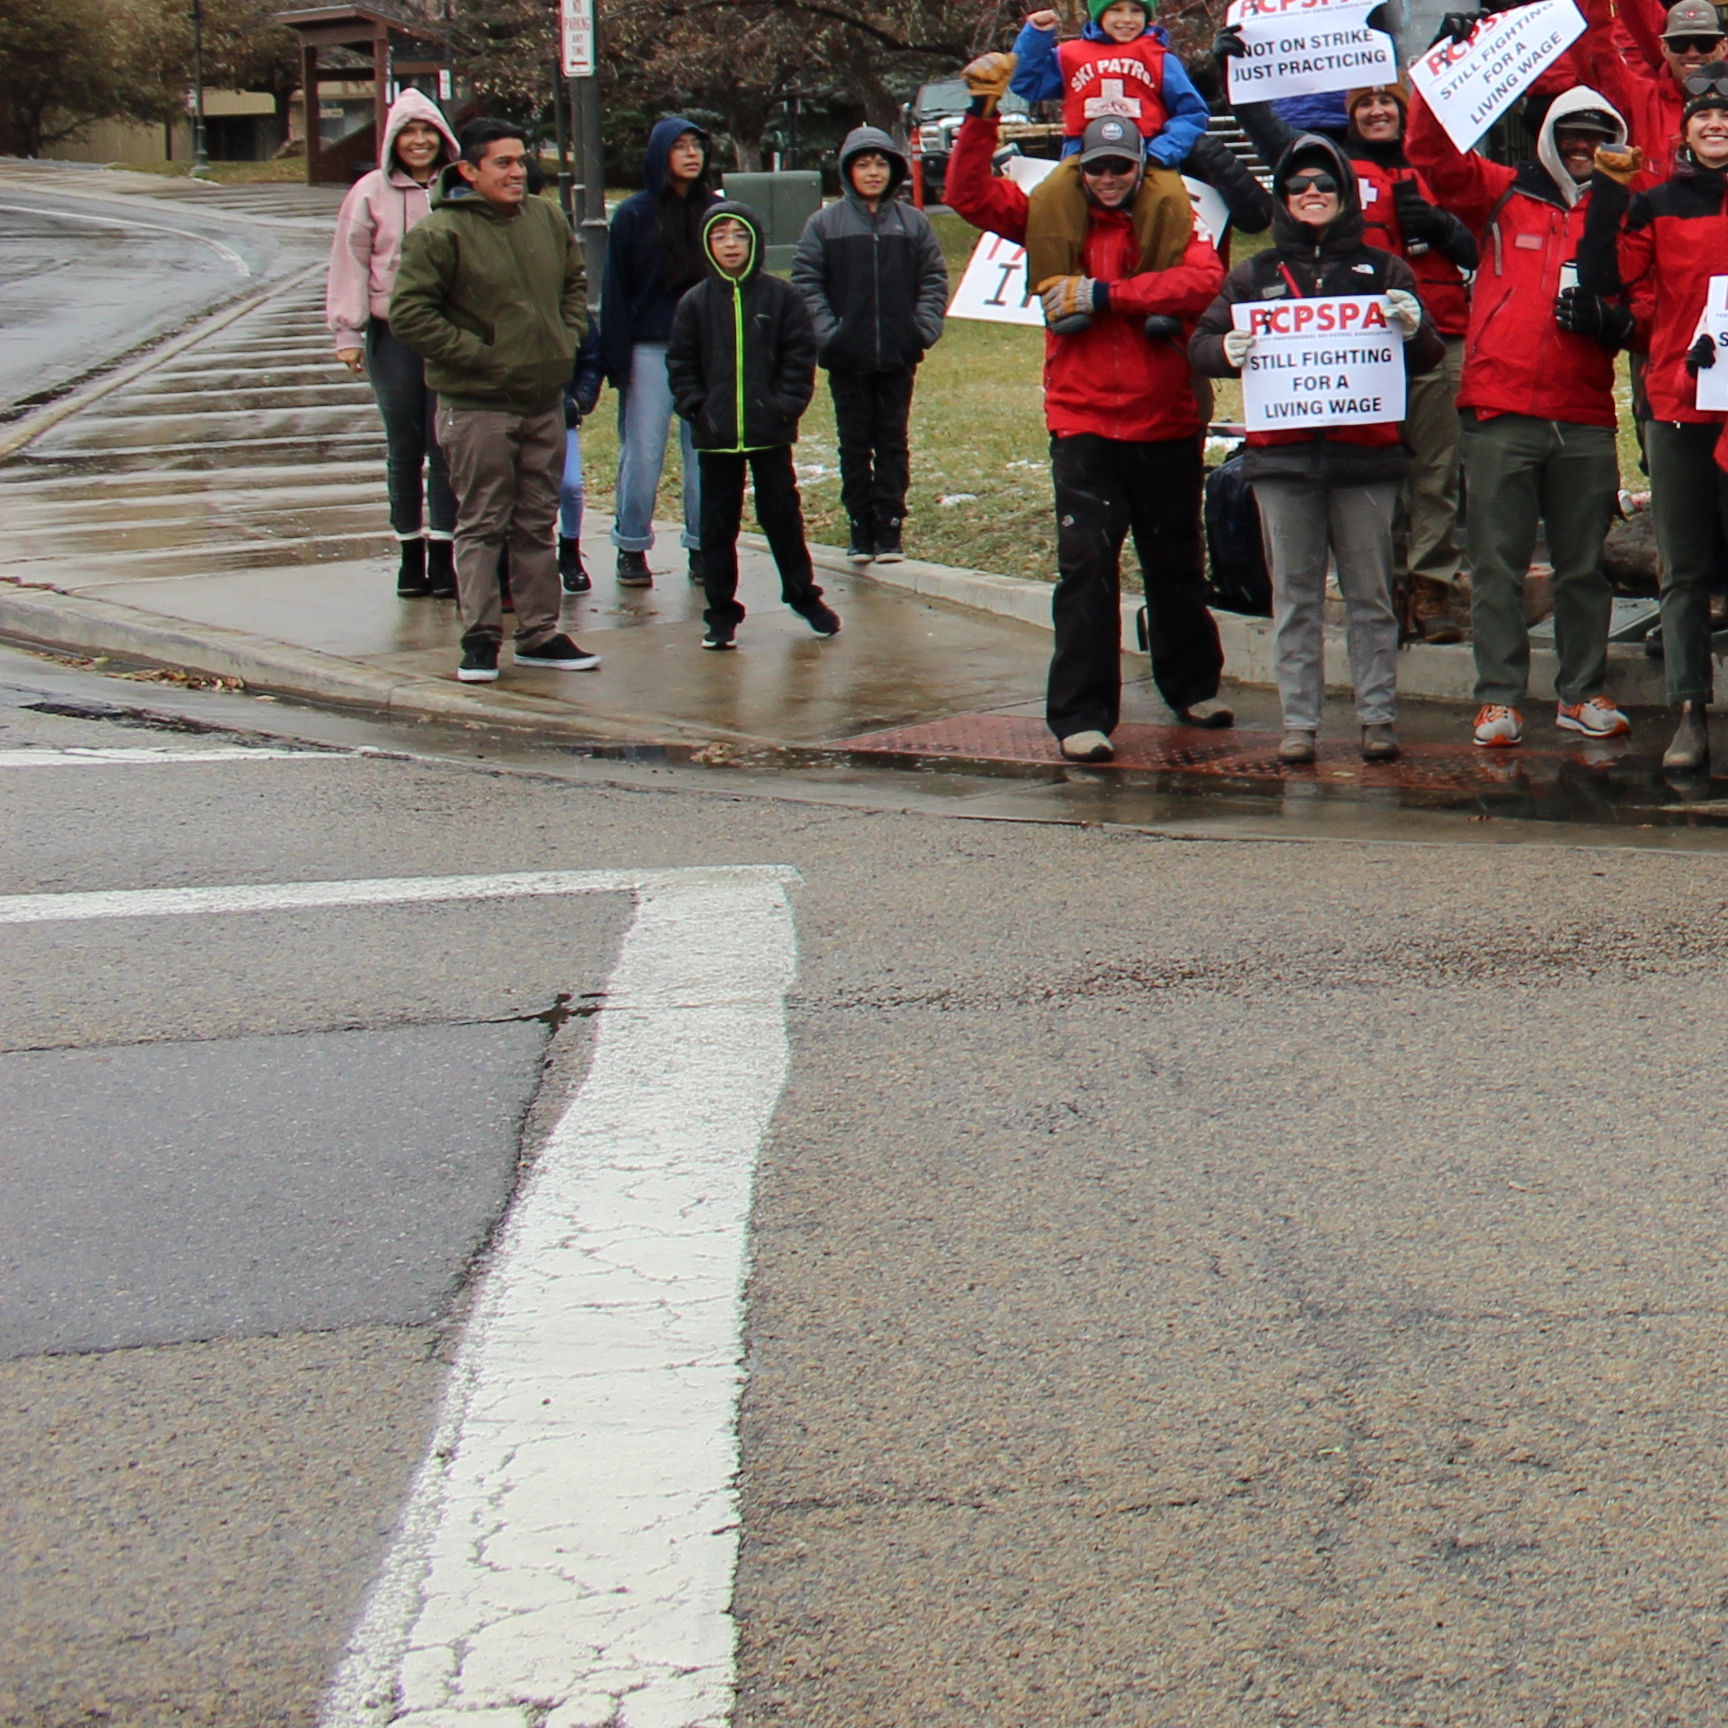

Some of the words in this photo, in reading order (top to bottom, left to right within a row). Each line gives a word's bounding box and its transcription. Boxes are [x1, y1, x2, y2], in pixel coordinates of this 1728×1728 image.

[1243, 41, 1274, 57] NOT
[1280, 37, 1305, 52] ON
[1310, 29, 1373, 49] STRIKE
[1440, 62, 1481, 100] STILL
[1482, 2, 1554, 62] FIGHTING
[1071, 63, 1095, 92] SKI
[1234, 62, 1276, 82] JUST
[1279, 50, 1387, 75] PRACTICING
[1482, 54, 1514, 84] FOR
[1516, 41, 1527, 55] A
[1470, 74, 1519, 125] LIVING
[1517, 31, 1563, 75] WAGE
[1250, 302, 1387, 335] PCPSPA
[1251, 353, 1297, 370] STILL
[1302, 348, 1392, 366] FIGHTING
[1293, 375, 1331, 391] FOR
[1336, 375, 1349, 389] A
[1265, 400, 1323, 418] LIVING
[1329, 397, 1382, 413] WAGE
